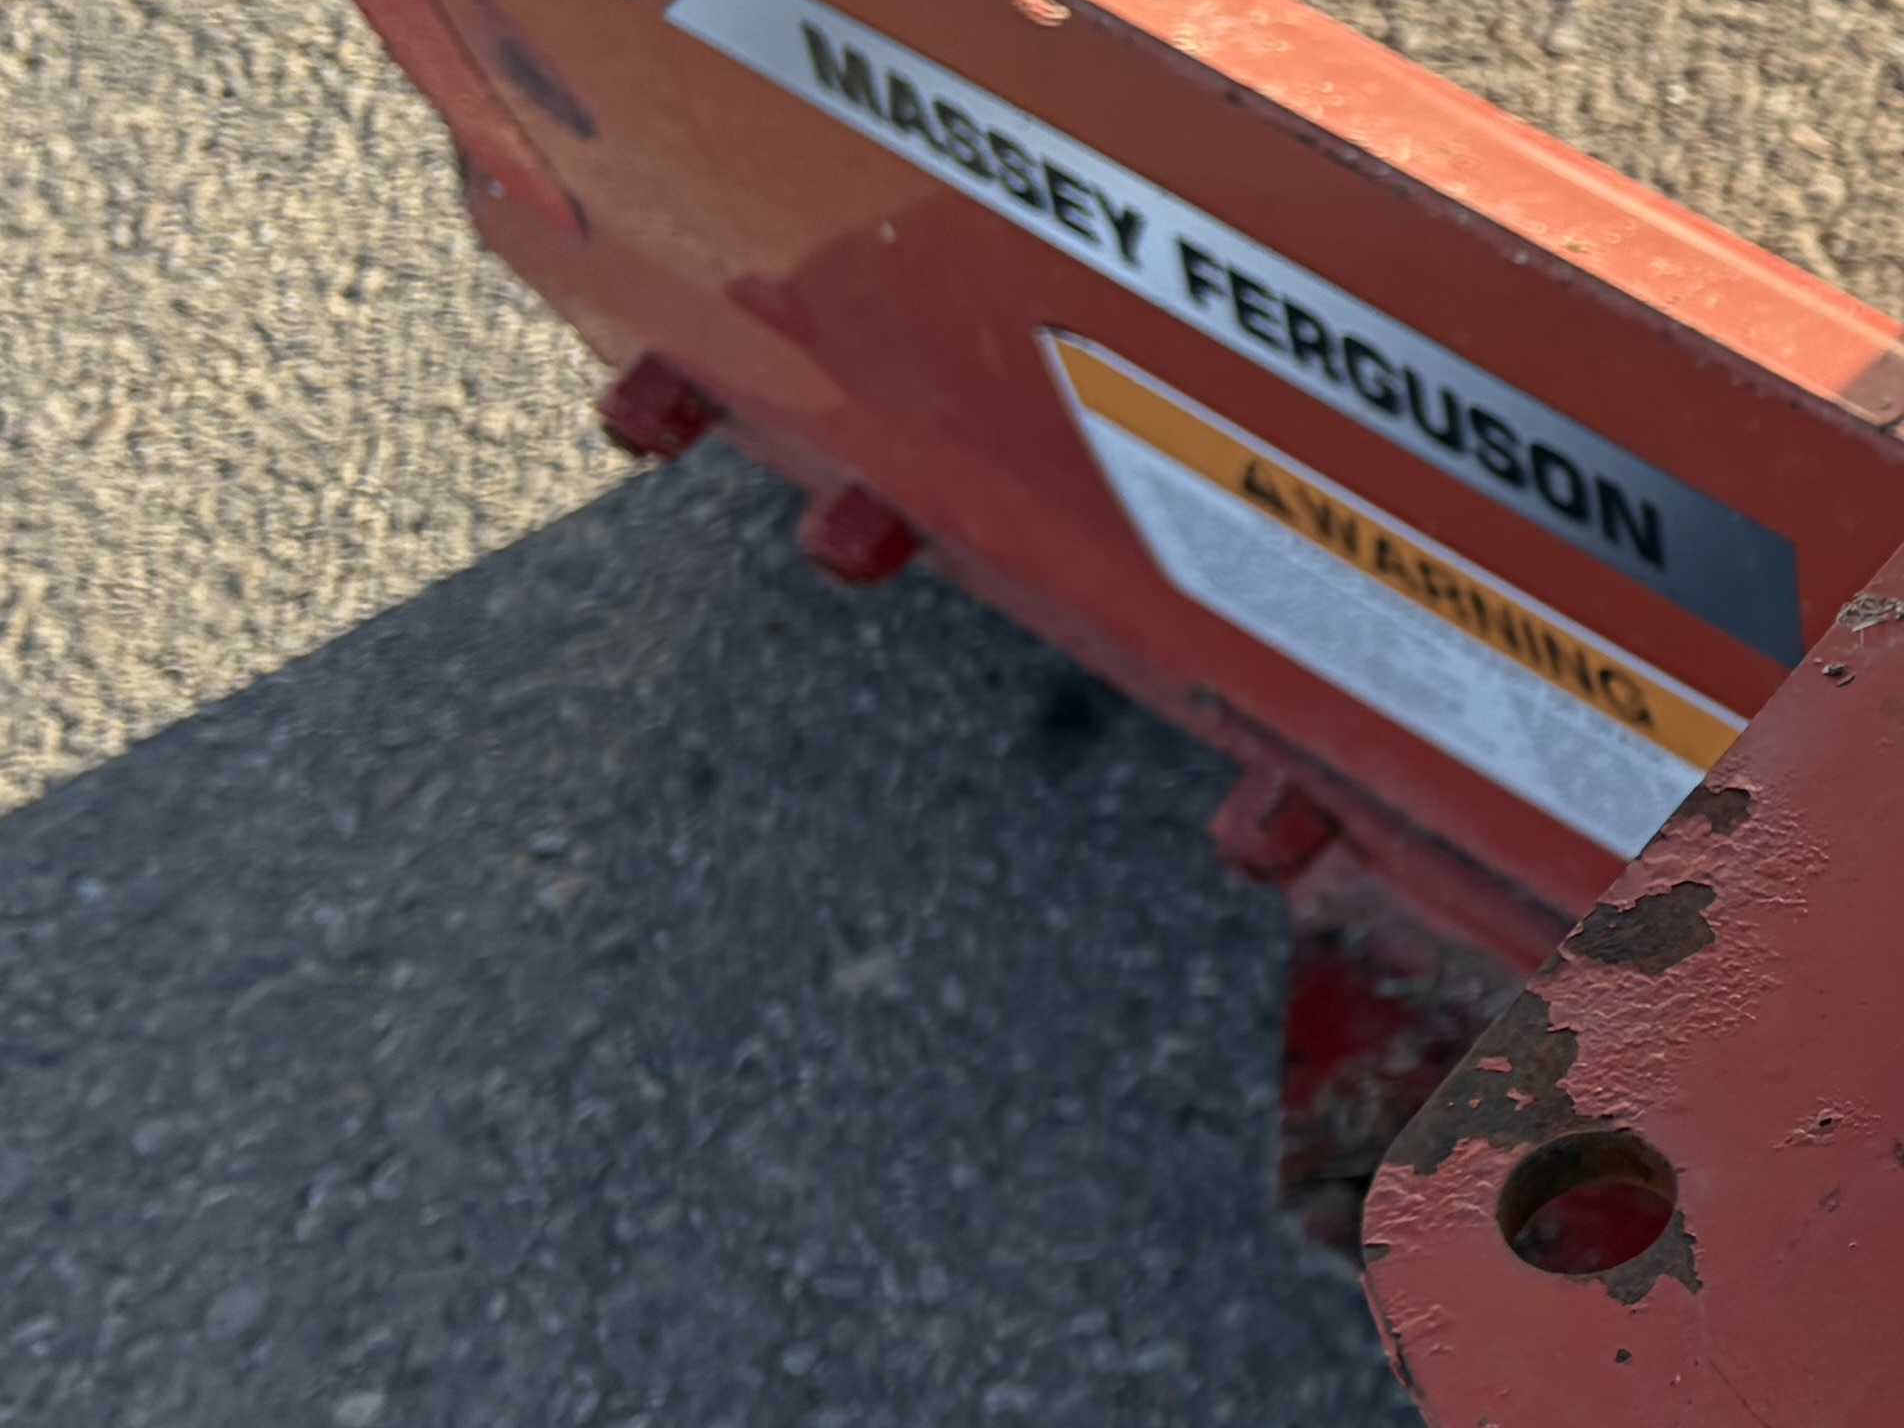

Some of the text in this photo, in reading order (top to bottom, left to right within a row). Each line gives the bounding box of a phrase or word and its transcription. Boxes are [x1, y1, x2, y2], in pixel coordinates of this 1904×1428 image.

[801, 22, 1667, 569] MASSEY FERGUSON
[1300, 484, 1655, 730] WARNING
